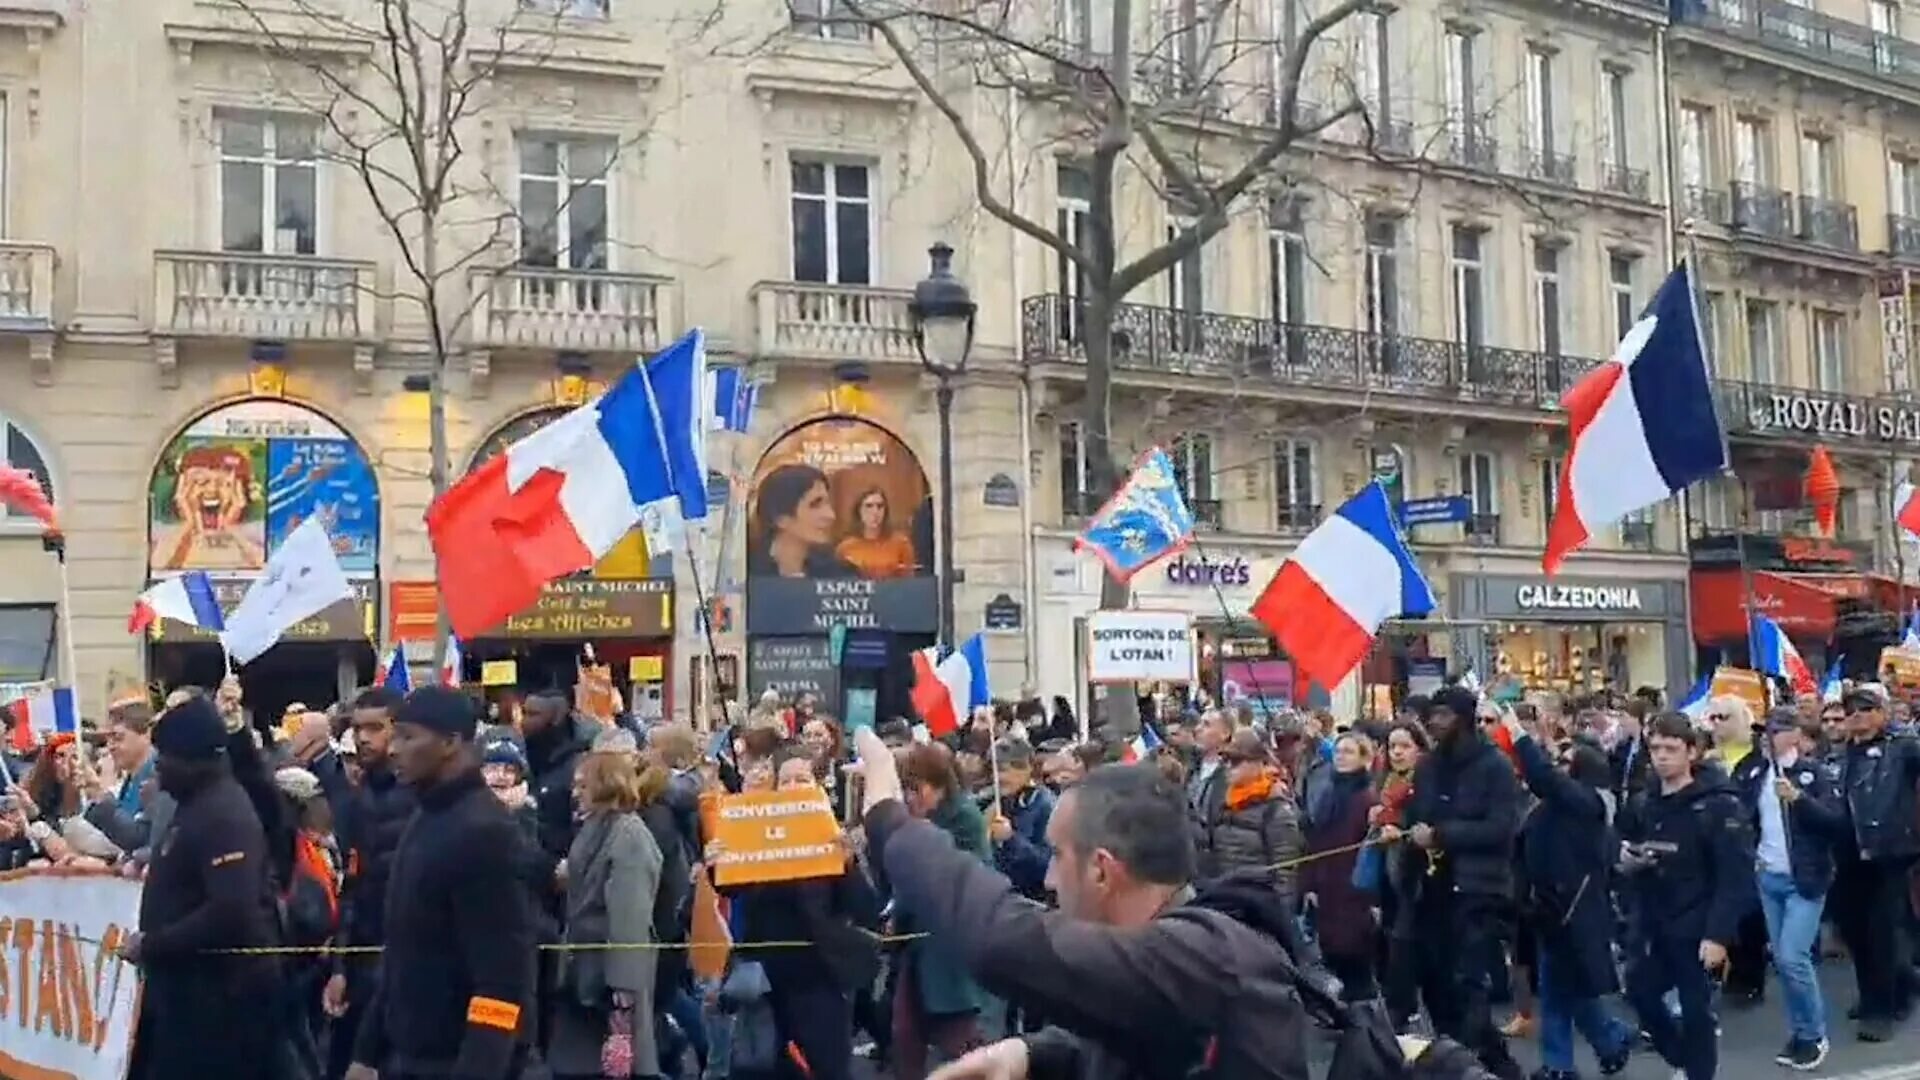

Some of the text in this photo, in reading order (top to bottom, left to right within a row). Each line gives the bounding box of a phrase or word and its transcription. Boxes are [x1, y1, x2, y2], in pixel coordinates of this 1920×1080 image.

[1771, 394, 1867, 435] ROYAL
[1167, 555, 1250, 585] claire's
[600, 581, 667, 592] MICHEL
[815, 581, 876, 595] ESPACE
[822, 597, 870, 611] SAINT
[1518, 585, 1642, 610] CALZEDONIA
[1093, 628, 1187, 642] SORTONS DE
[1110, 649, 1164, 662] L'OTAN
[764, 826, 786, 840] LE
